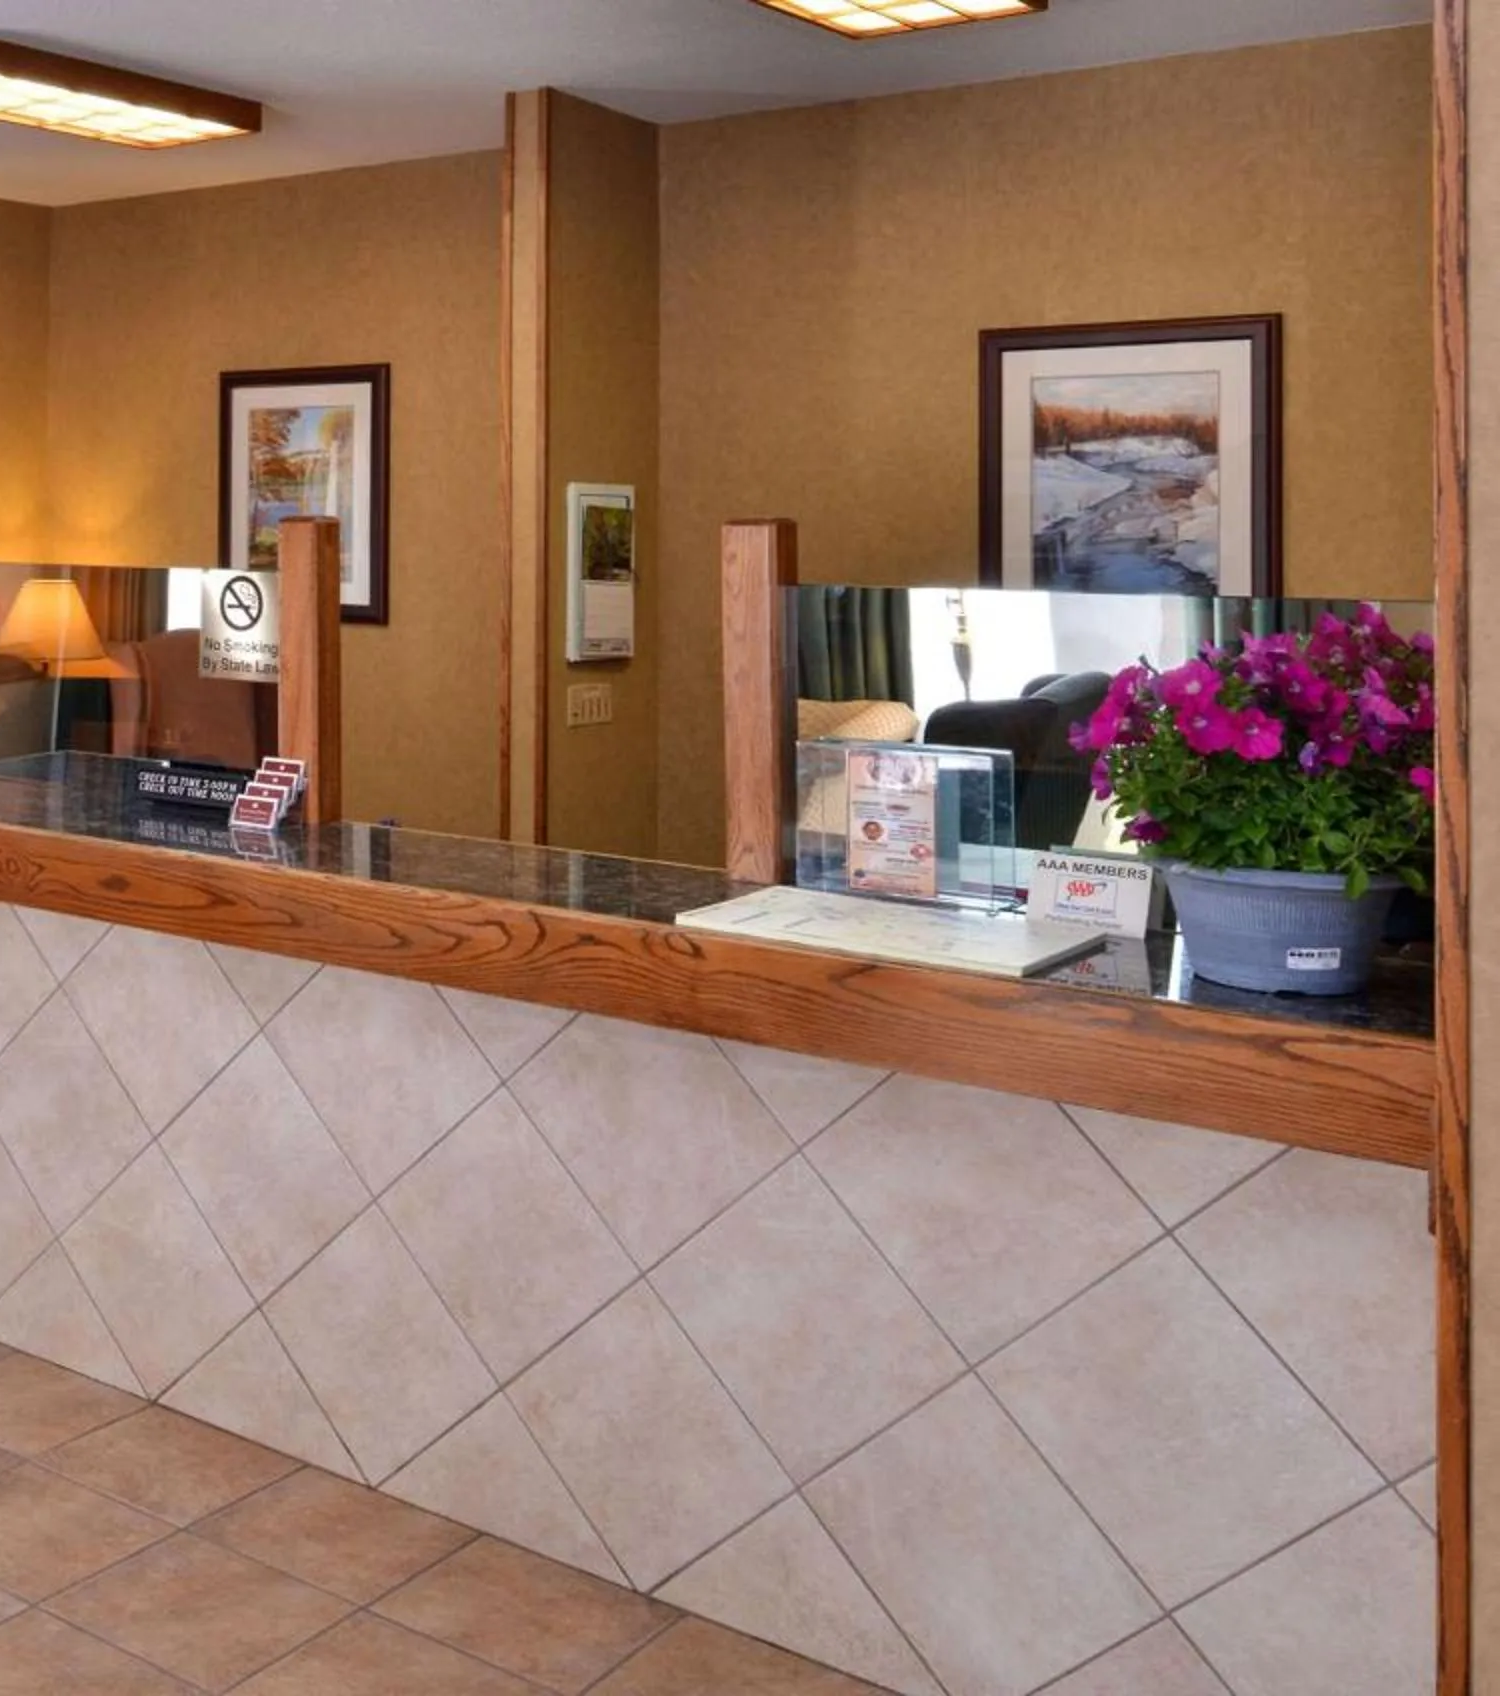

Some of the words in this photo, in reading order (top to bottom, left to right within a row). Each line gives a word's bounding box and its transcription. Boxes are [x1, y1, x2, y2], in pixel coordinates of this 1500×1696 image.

[204, 636, 221, 651] No
[223, 638, 278, 659] Smoking
[202, 656, 217, 673] By
[221, 657, 252, 673] State
[138, 772, 166, 783] CHECK
[179, 776, 202, 788] TIME
[139, 781, 166, 793] CHECK
[167, 785, 186, 796] OUT
[186, 787, 209, 799] TIME
[1037, 859, 1069, 872] AAA
[1071, 862, 1149, 881] MEMBERS
